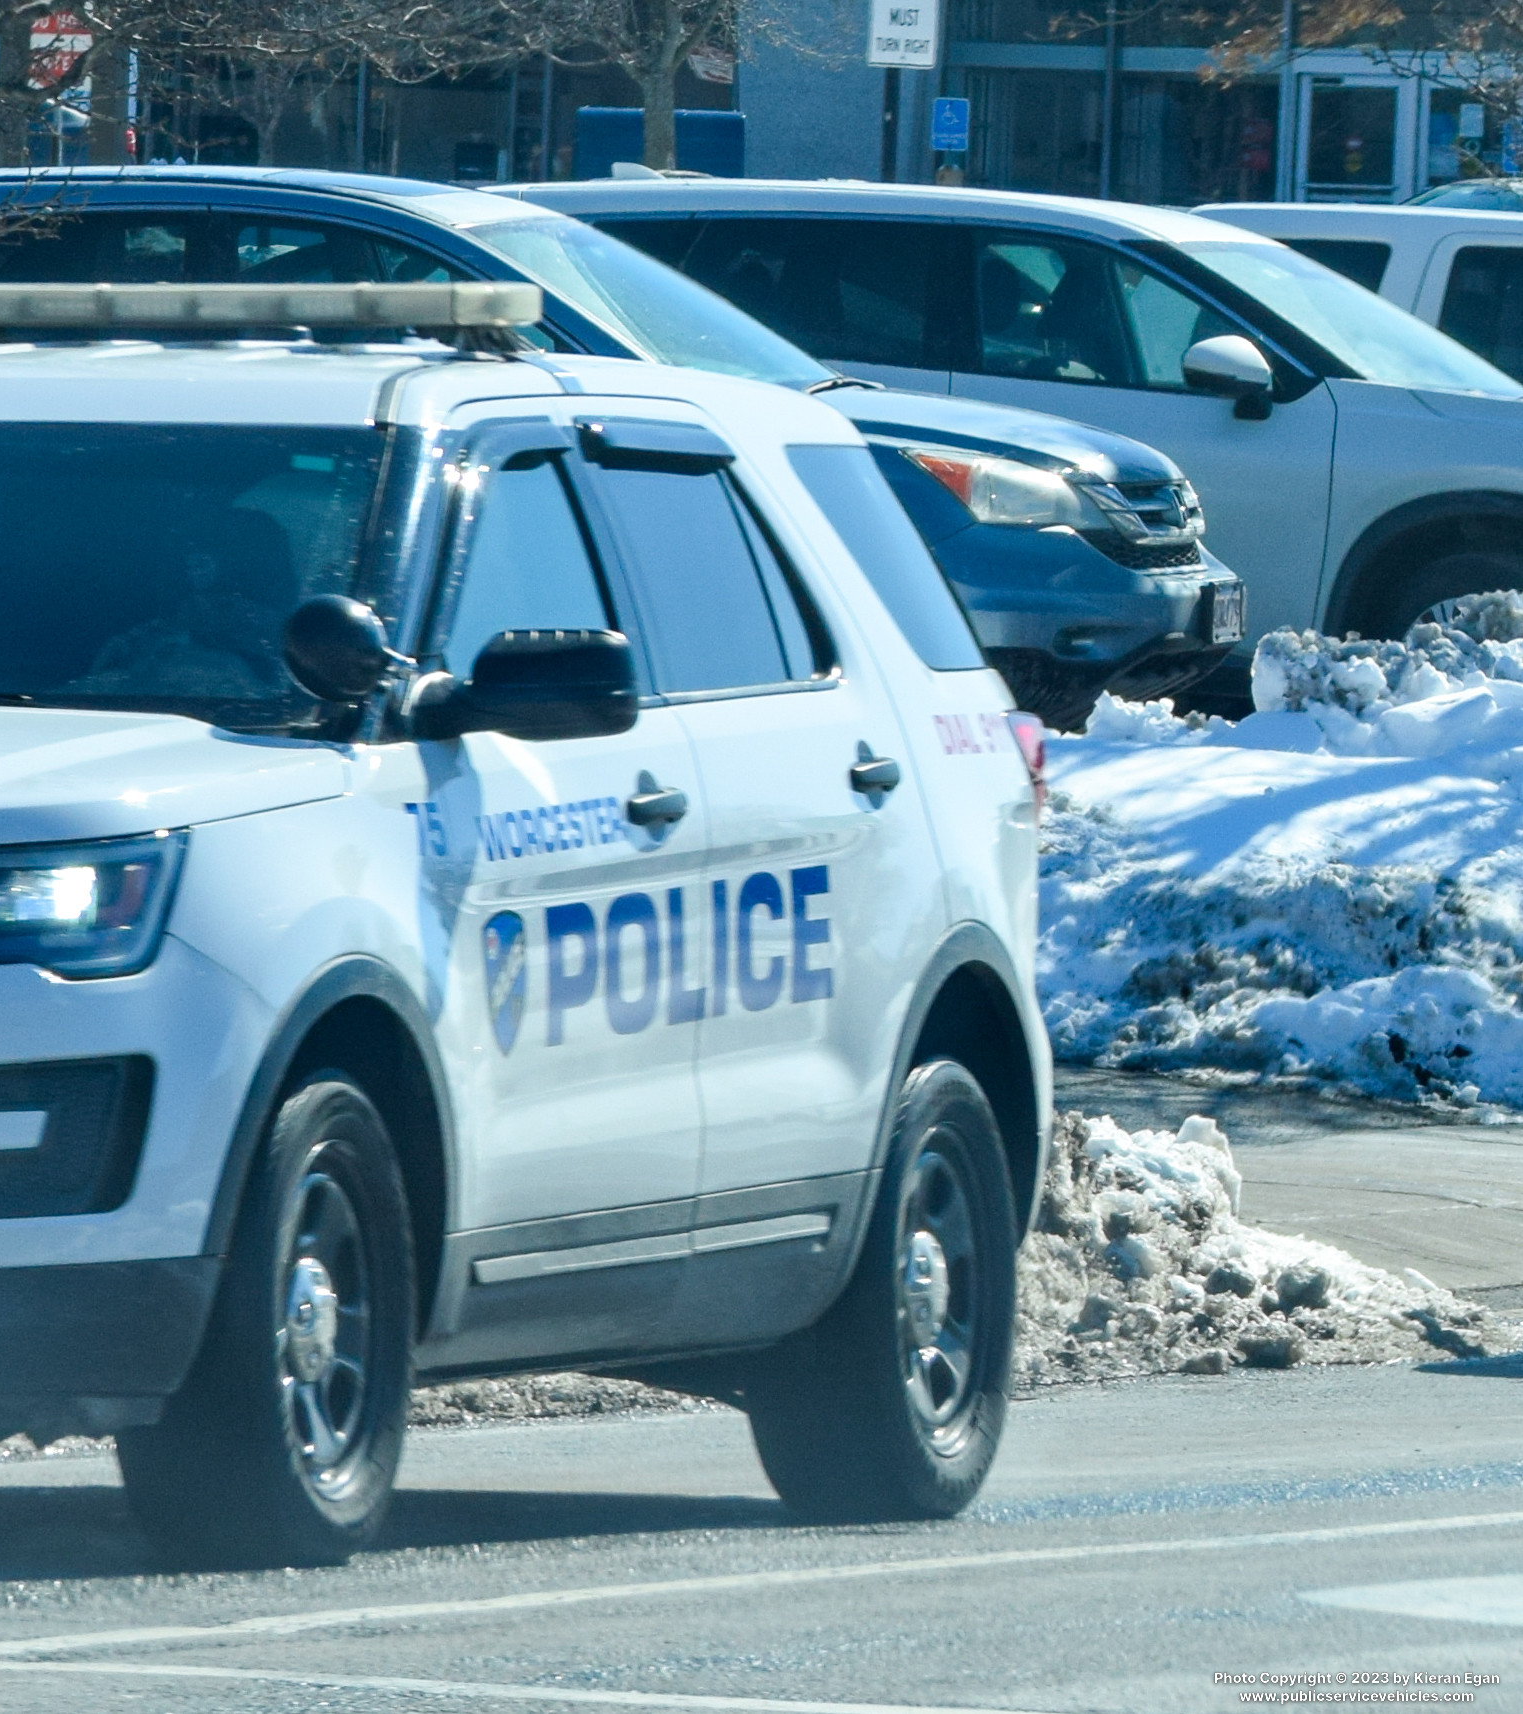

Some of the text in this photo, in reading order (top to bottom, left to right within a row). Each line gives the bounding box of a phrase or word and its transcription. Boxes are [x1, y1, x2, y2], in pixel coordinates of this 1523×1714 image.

[889, 7, 919, 26] MUST
[876, 37, 930, 54] TURN RIGHT
[932, 713, 983, 755] DIAL
[475, 796, 630, 862] WORCESTER
[544, 864, 834, 1047] POLICE
